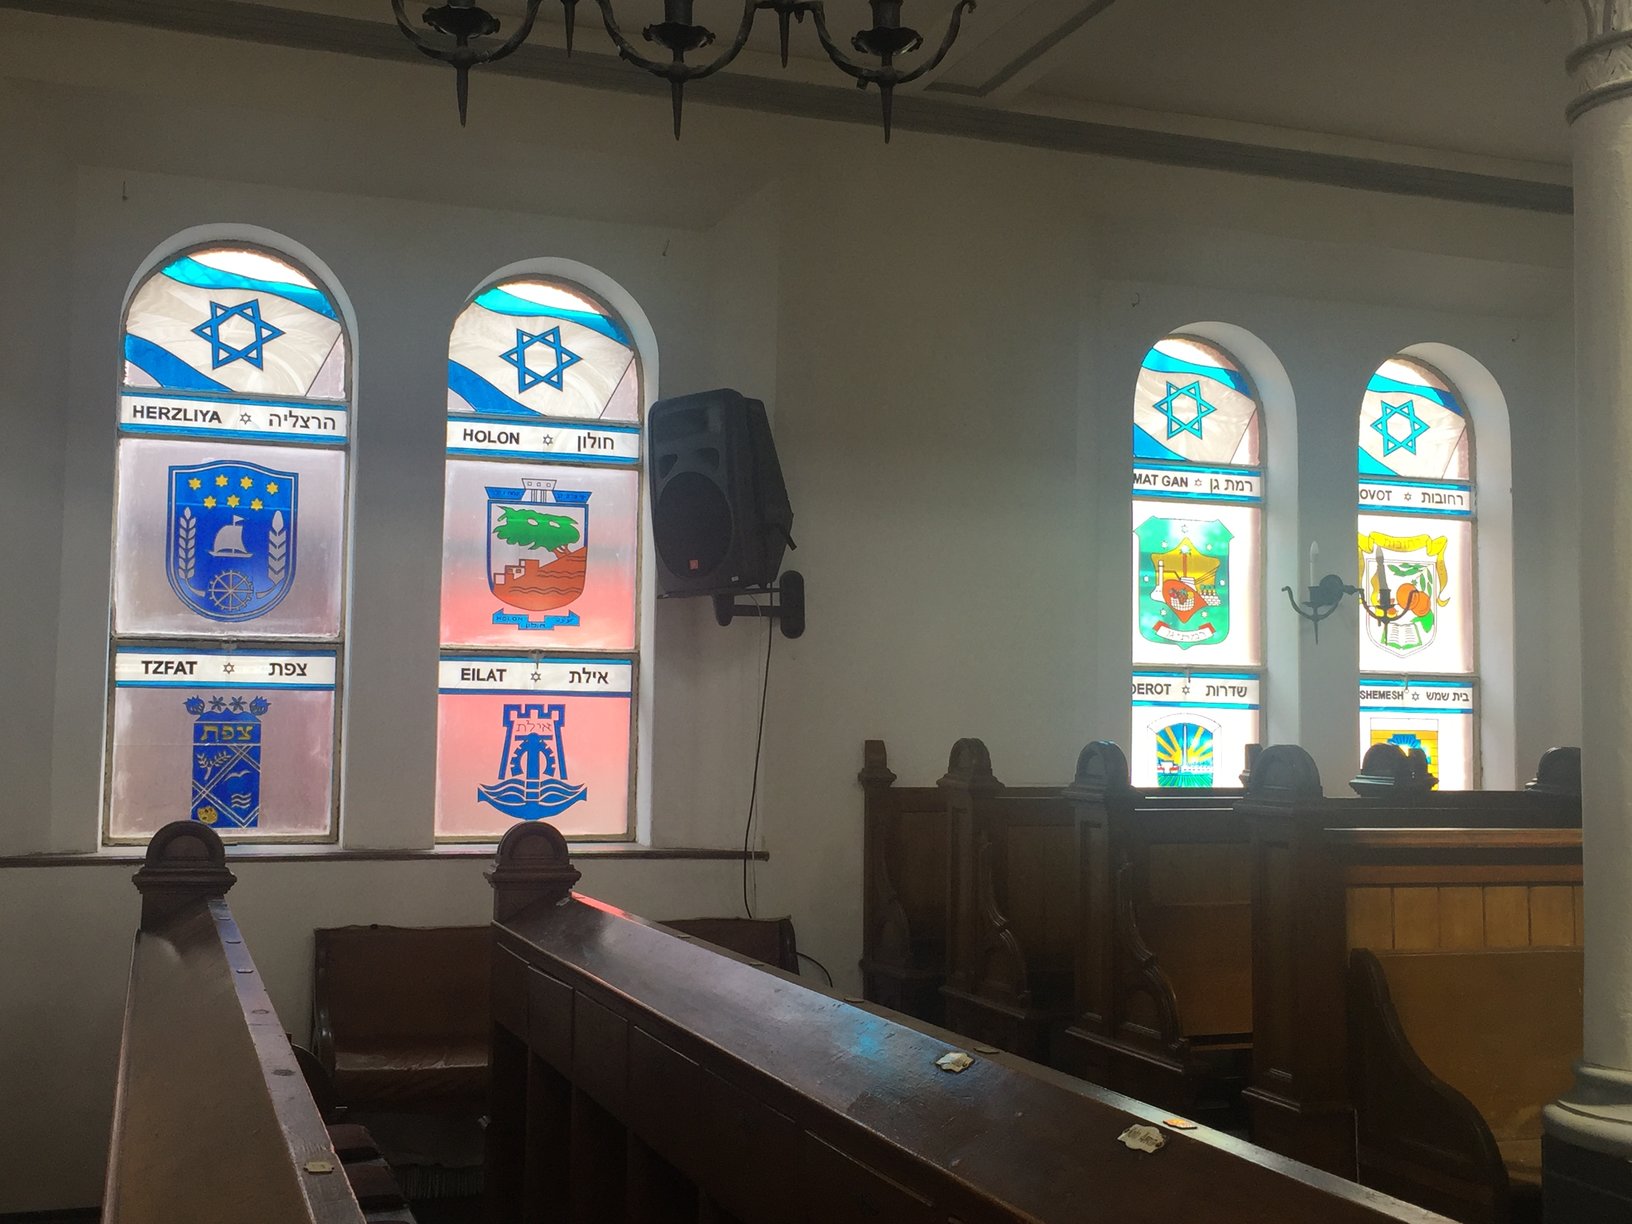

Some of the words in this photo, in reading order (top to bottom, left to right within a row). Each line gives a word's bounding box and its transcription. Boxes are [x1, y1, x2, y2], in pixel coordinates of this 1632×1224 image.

[132, 405, 222, 424] HERZLIYA
[268, 410, 336, 430] הרצליה
[463, 428, 520, 445] HOLON
[577, 432, 615, 452] חולון
[1161, 475, 1188, 488] GAN
[1209, 478, 1220, 494] גן
[1224, 478, 1253, 492] רמת
[1421, 492, 1464, 506] רחובות
[141, 660, 198, 675] TZFAT
[268, 662, 308, 677] צפת
[461, 667, 507, 683] EILAT
[568, 667, 609, 684] אילת
[1205, 684, 1248, 698] שדרות
[1359, 690, 1404, 700] SHEMESH
[1426, 691, 1450, 702] שמש
[1452, 692, 1470, 702] בית
[515, 719, 553, 732] אילת
[200, 725, 254, 742] צפת
